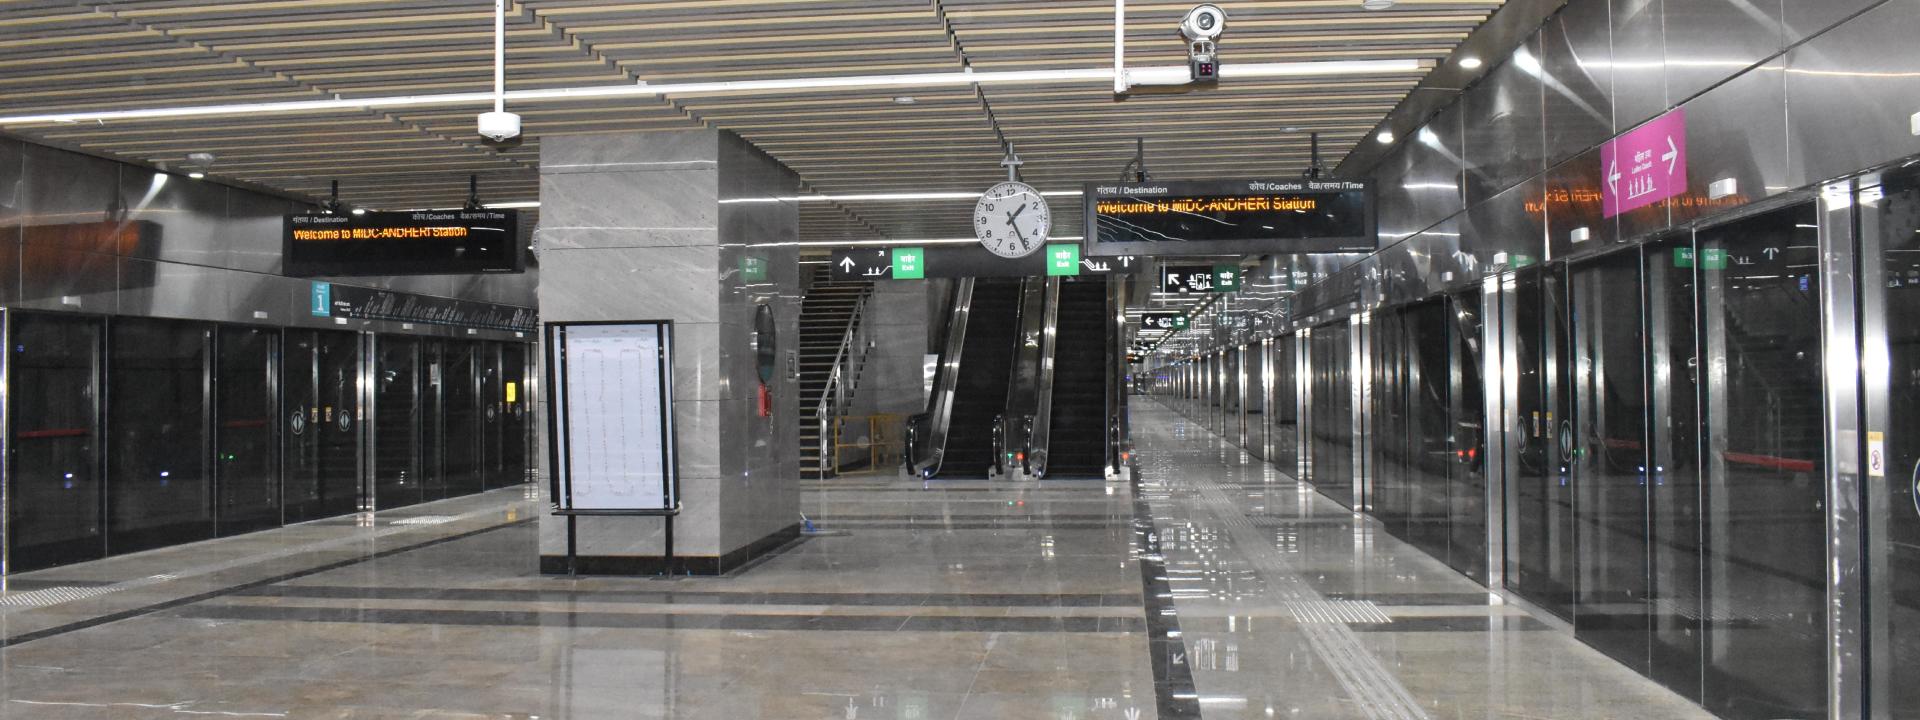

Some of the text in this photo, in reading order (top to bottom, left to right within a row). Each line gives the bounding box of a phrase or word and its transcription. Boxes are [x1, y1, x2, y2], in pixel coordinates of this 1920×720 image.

[1124, 186, 1168, 194] Destination
[995, 193, 1002, 201] 11
[985, 203, 994, 212] 10
[1032, 201, 1039, 210] 2
[1096, 197, 1316, 213] Welcome to MIDC-ANDHERI Station
[981, 216, 987, 225] 9
[294, 227, 467, 240] Welcome to MIDC-ANDHERI Station
[986, 230, 992, 238] 8
[996, 239, 1003, 247] 7
[1023, 238, 1029, 246] 5
[1009, 243, 1015, 251] 6
[317, 294, 323, 311] 1
